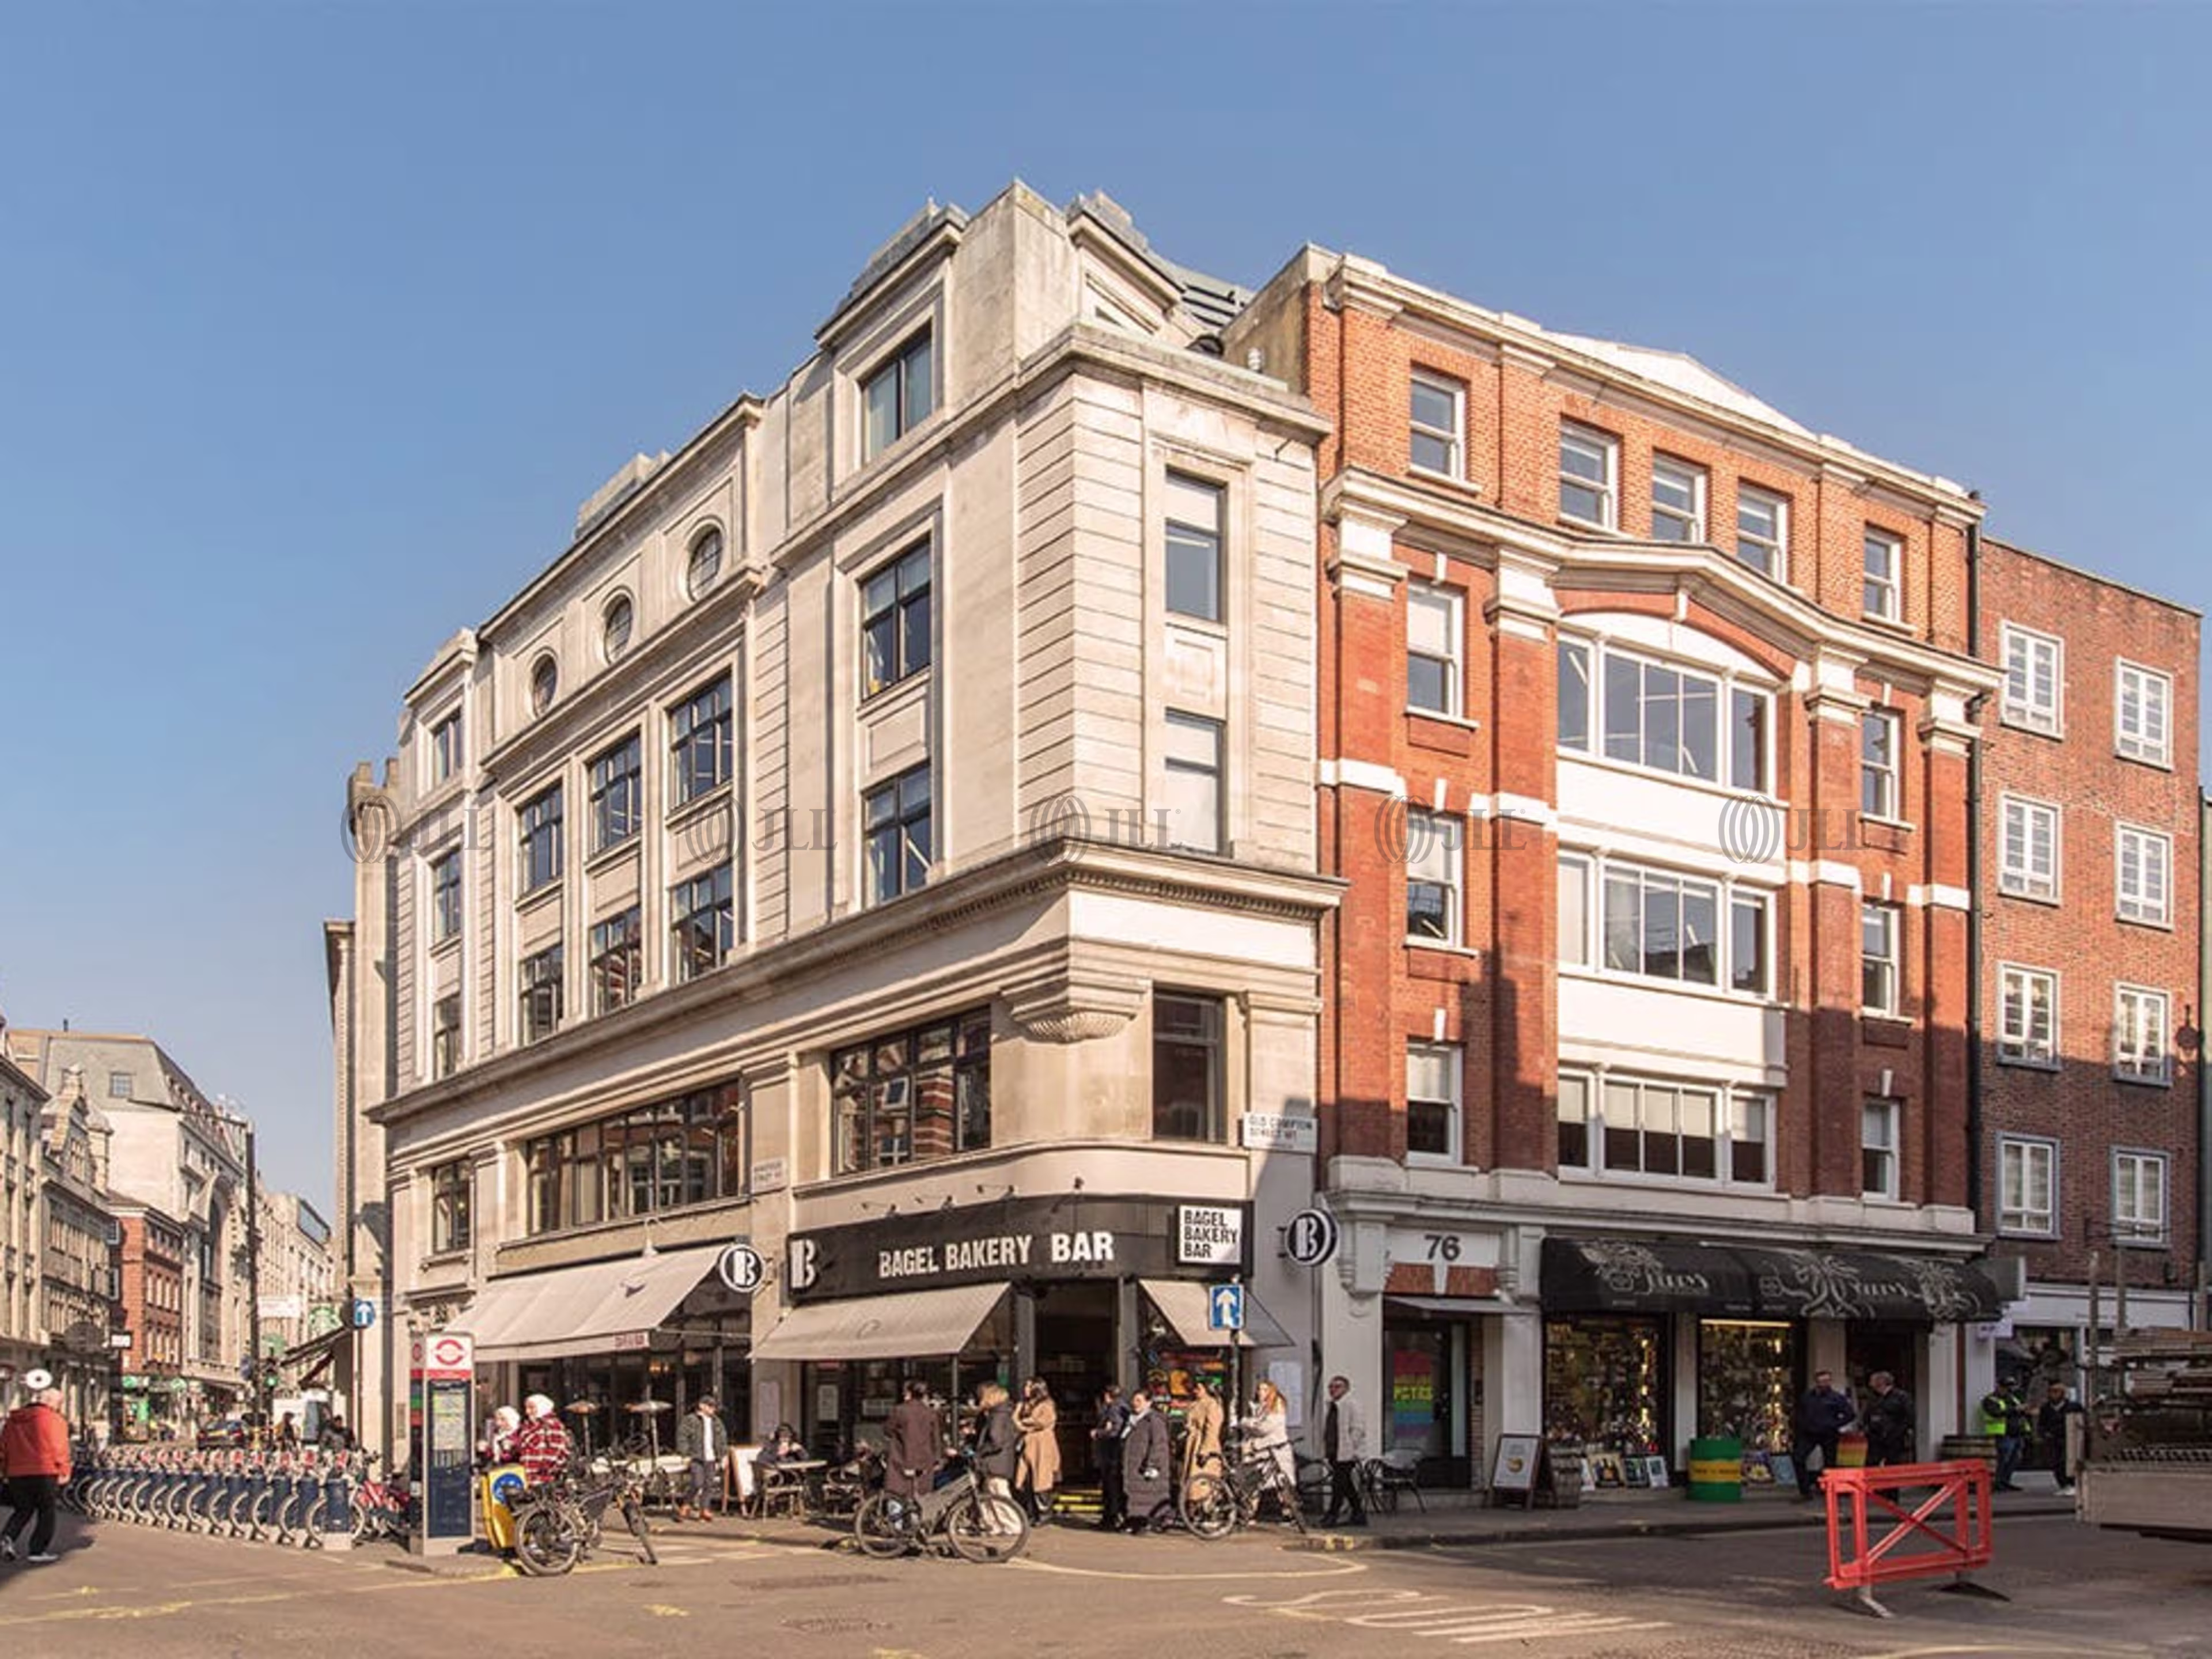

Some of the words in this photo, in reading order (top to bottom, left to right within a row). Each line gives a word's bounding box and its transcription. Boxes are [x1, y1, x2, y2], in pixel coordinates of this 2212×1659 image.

[1184, 1210, 1228, 1226] BAGEL
[1184, 1225, 1237, 1243] BAKERY
[879, 1246, 939, 1278] BAGEL
[945, 1235, 1032, 1271] BAKERY
[1051, 1231, 1114, 1263] BAR
[1184, 1241, 1212, 1257] BAR
[1425, 1234, 1461, 1260] 76
